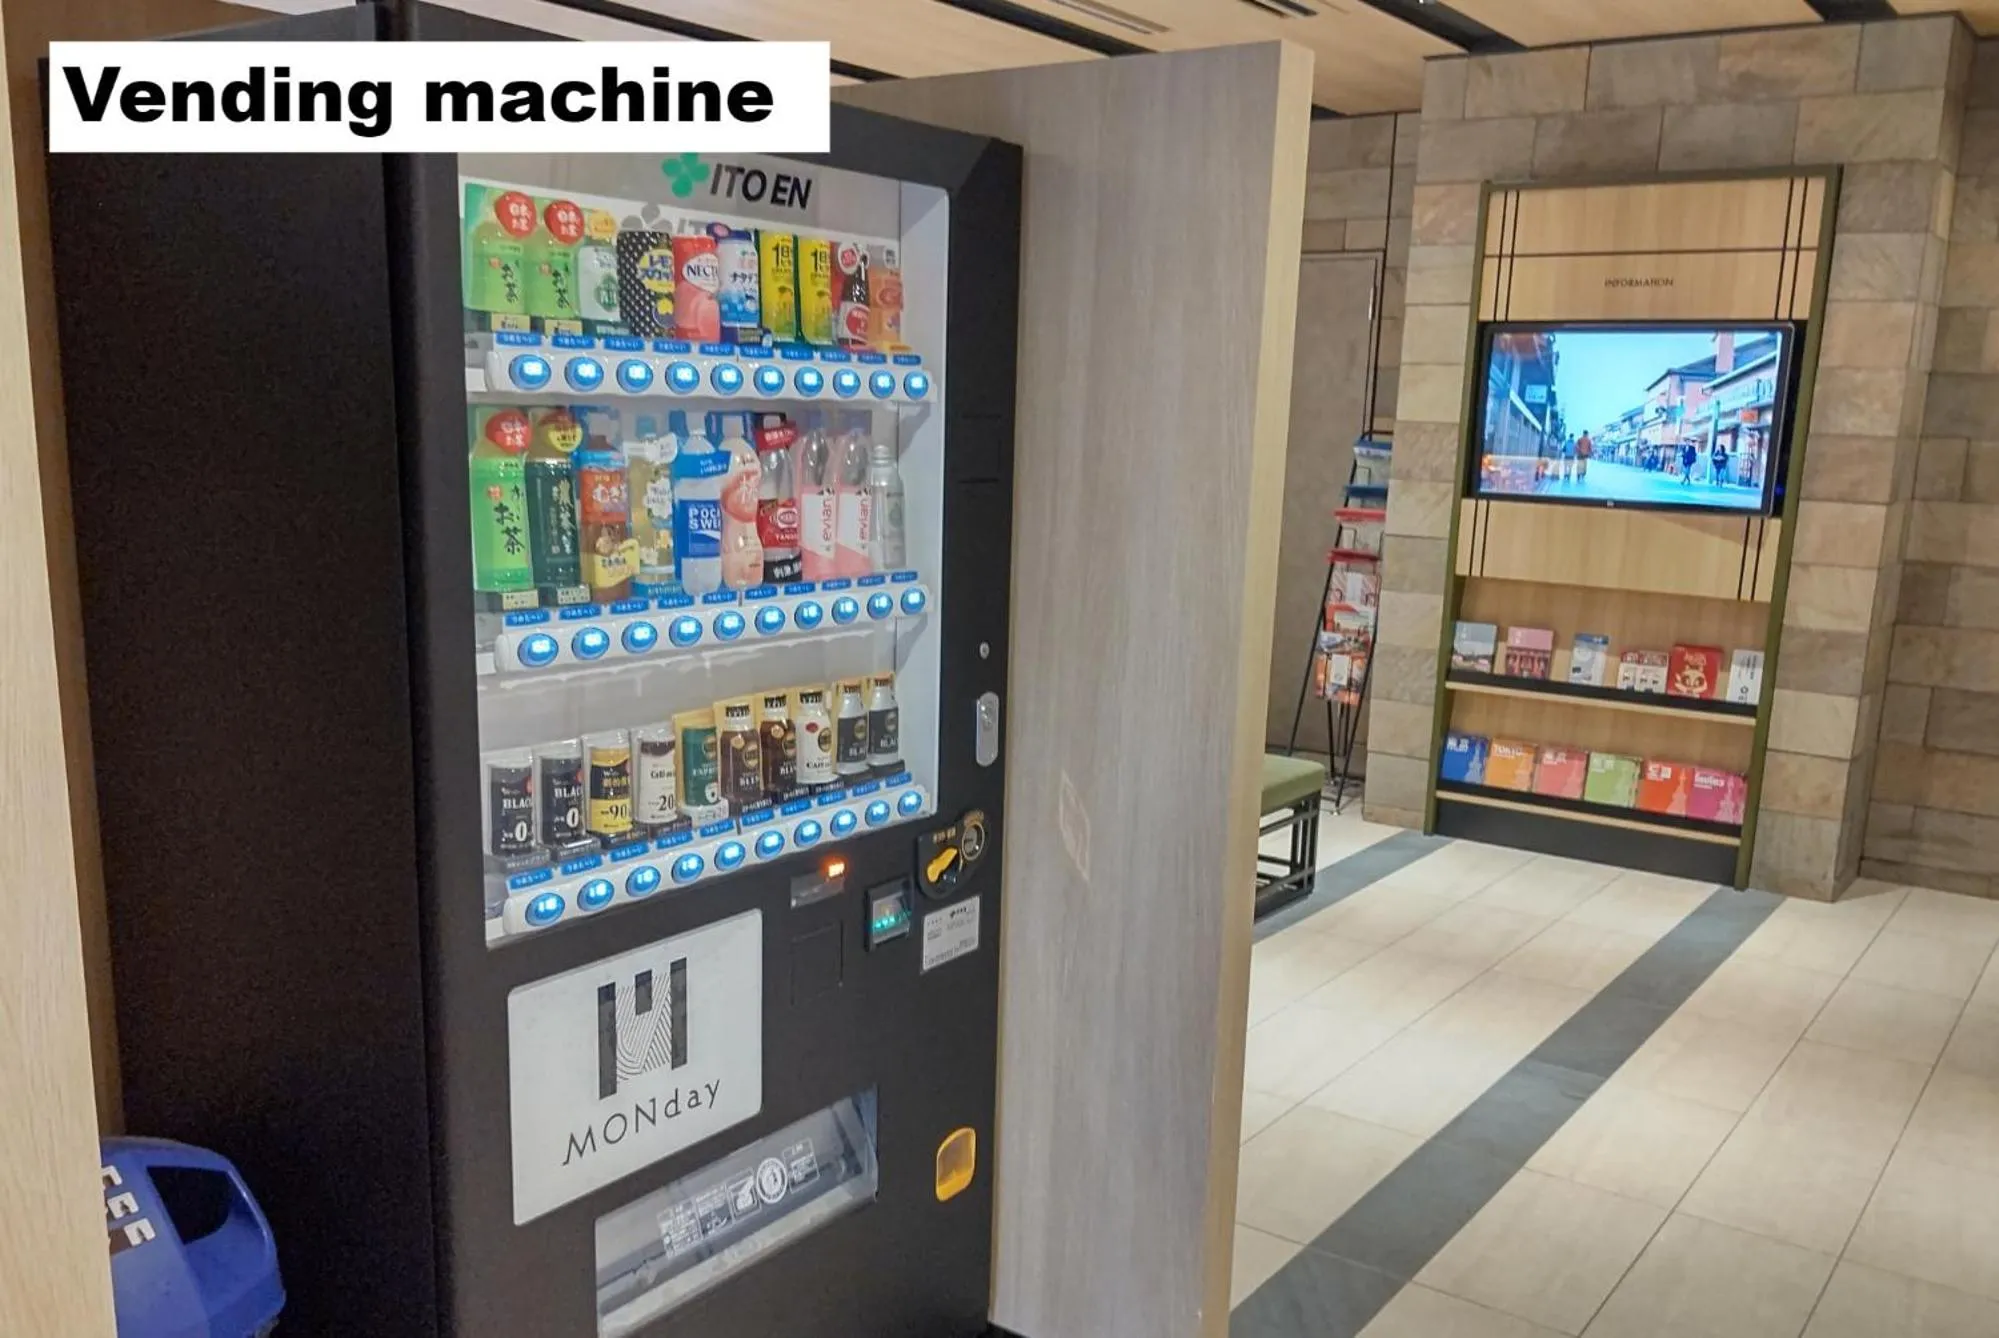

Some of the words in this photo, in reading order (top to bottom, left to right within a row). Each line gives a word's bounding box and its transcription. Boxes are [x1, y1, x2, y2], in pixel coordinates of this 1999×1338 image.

[709, 163, 767, 202] ITO
[770, 173, 813, 210] EN
[609, 804, 627, 820] 90
[659, 794, 674, 811] 20
[566, 807, 579, 829] 0
[515, 820, 528, 842] 0
[563, 1079, 720, 1166] MONday
